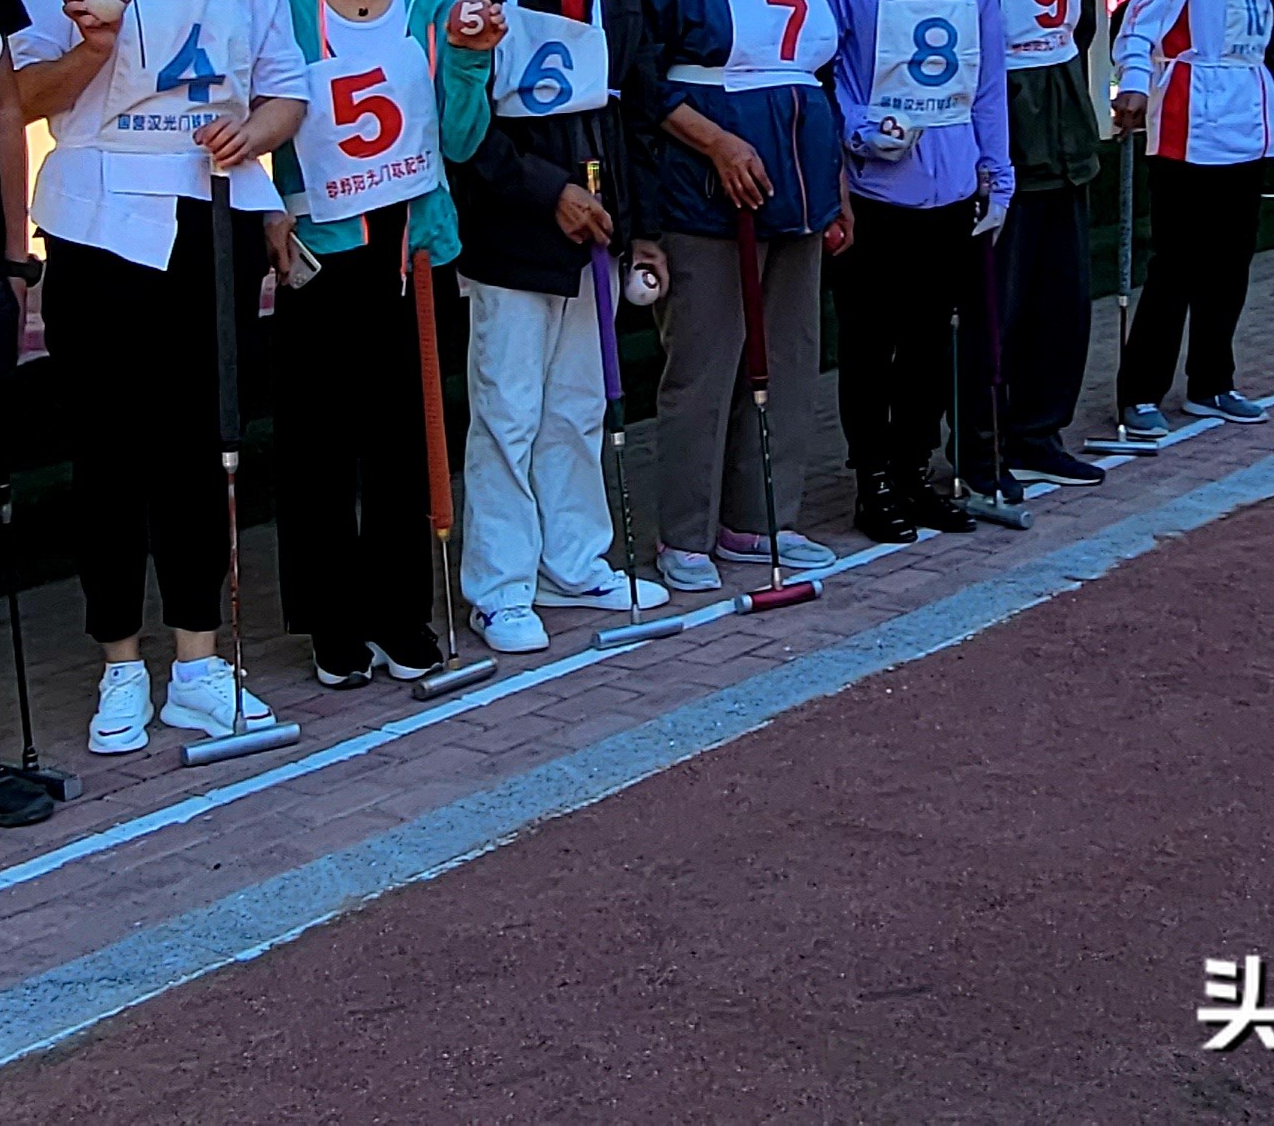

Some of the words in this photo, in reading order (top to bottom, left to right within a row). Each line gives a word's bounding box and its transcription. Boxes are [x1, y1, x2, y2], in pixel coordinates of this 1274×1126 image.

[460, 1, 484, 35] 5
[907, 17, 960, 87] 8
[156, 23, 227, 103] 4
[518, 40, 574, 114] 6
[330, 66, 403, 159] 5
